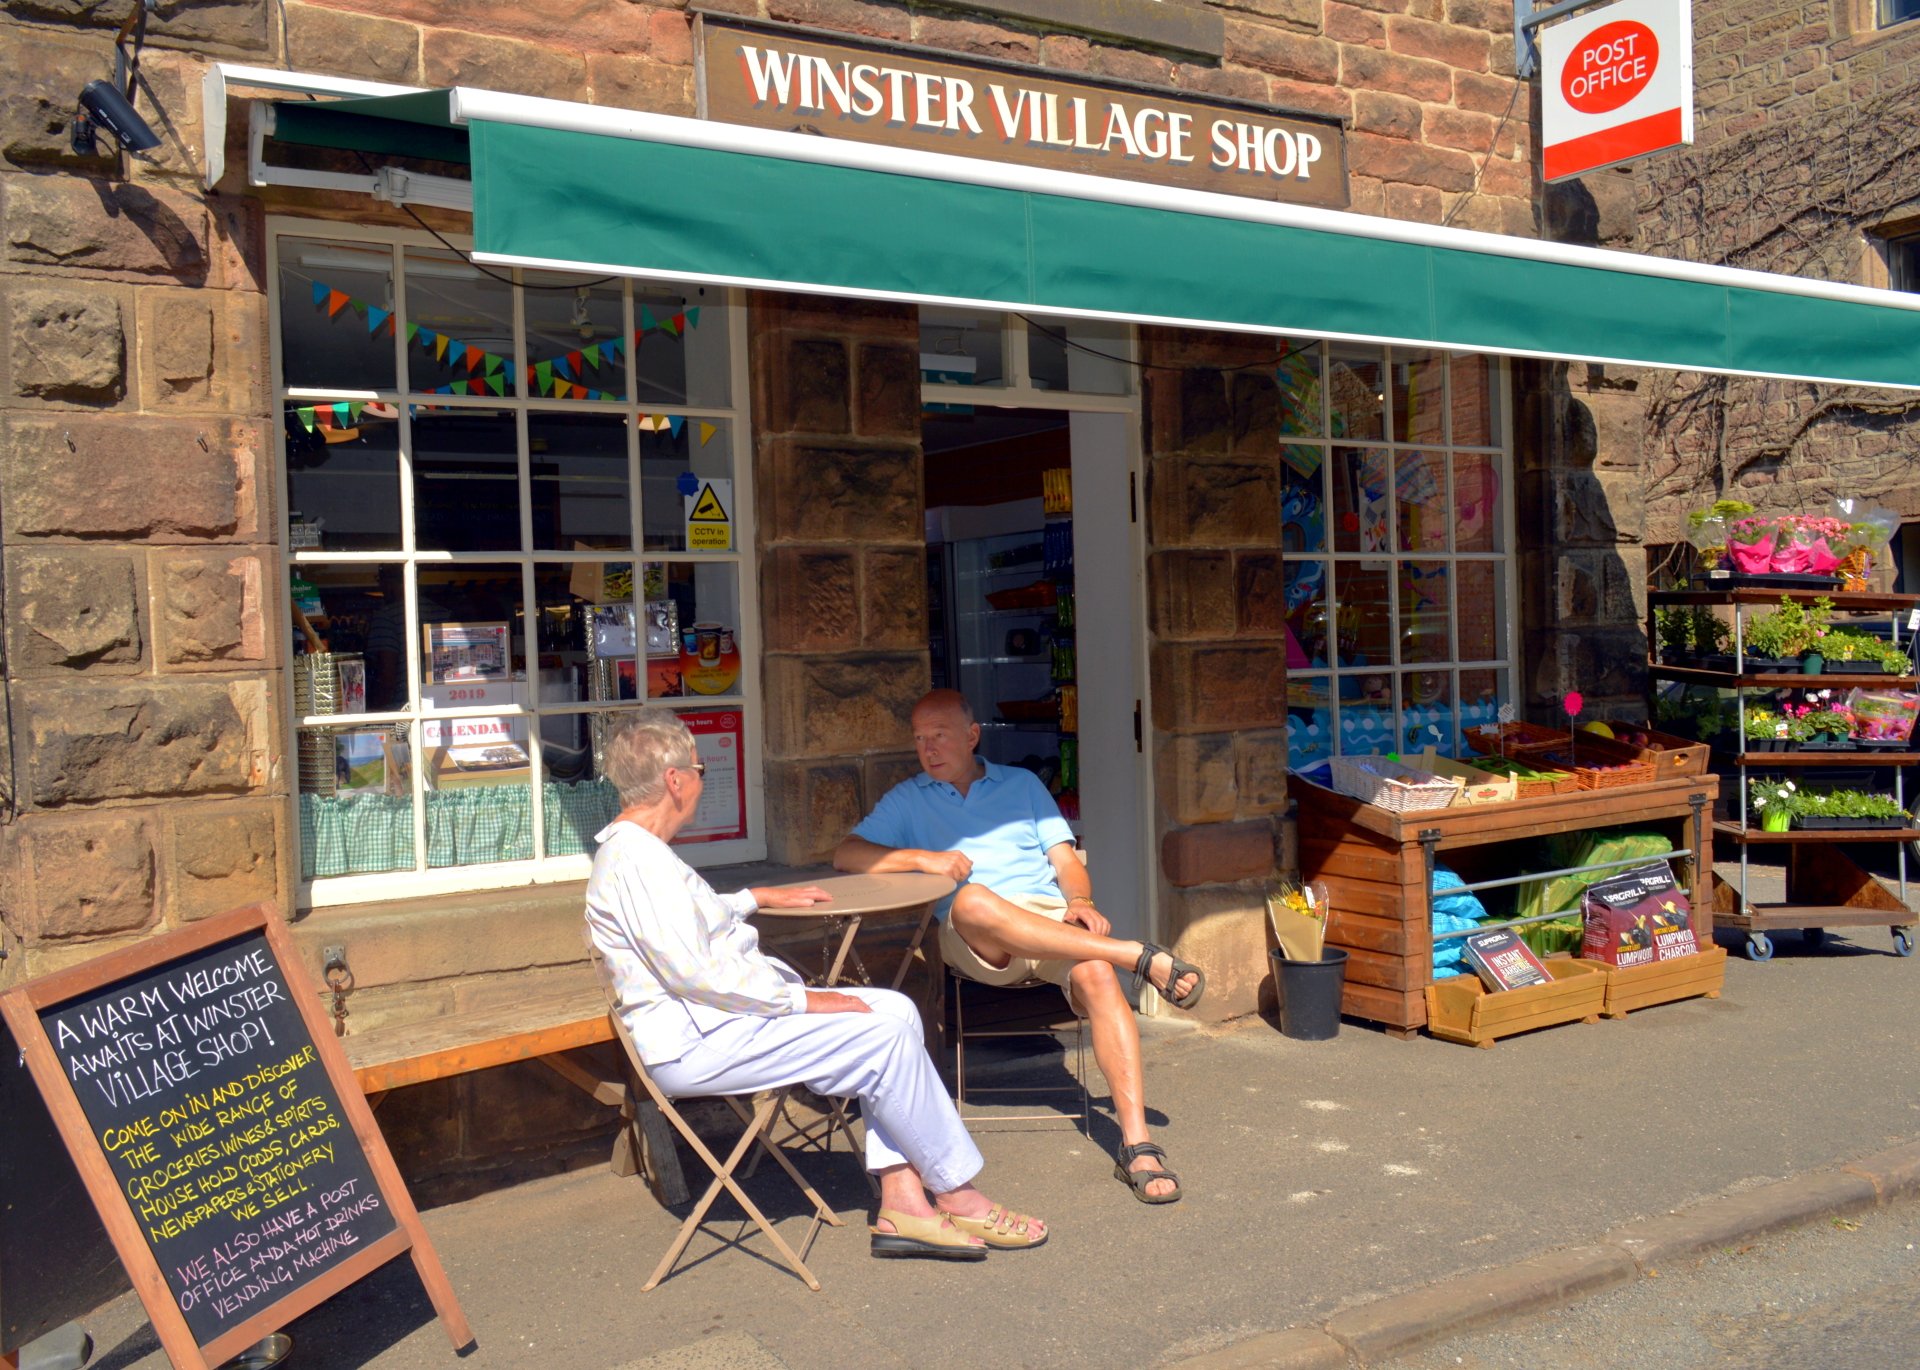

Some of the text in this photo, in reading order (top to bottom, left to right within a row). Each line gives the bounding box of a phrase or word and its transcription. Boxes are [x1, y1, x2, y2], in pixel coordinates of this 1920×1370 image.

[1570, 56, 1647, 98] OFFICE
[1583, 33, 1638, 71] POST
[741, 45, 1321, 179] WINSTER VILLAGE SHOP
[692, 537, 727, 545] operation
[449, 689, 486, 700] 2019
[1491, 949, 1524, 967] INSTANT
[1659, 943, 1698, 961] CHARCOAL
[57, 949, 273, 1049] A WARM WELCOME
[70, 981, 286, 1080] AWAITS AT WINSTER
[97, 1017, 275, 1107] VILLAGE SHOP!
[103, 1045, 316, 1151] COME ON IN AND DISCOVER
[120, 1078, 299, 1169] THE WIDE RANGE OF
[139, 1182, 199, 1222] HOUSE
[198, 1166, 238, 1193] HOLD
[289, 1114, 340, 1148] CARDS,
[150, 1187, 247, 1244] NEWSPAPERS
[176, 1178, 358, 1286] WE ALSO HAVE A POST
[180, 1266, 248, 1312] OFFICE
[294, 1222, 322, 1246] HOT
[325, 1193, 380, 1231] DRINKS
[231, 1201, 261, 1222] WE
[211, 1229, 359, 1319] VENDING MACHINE
